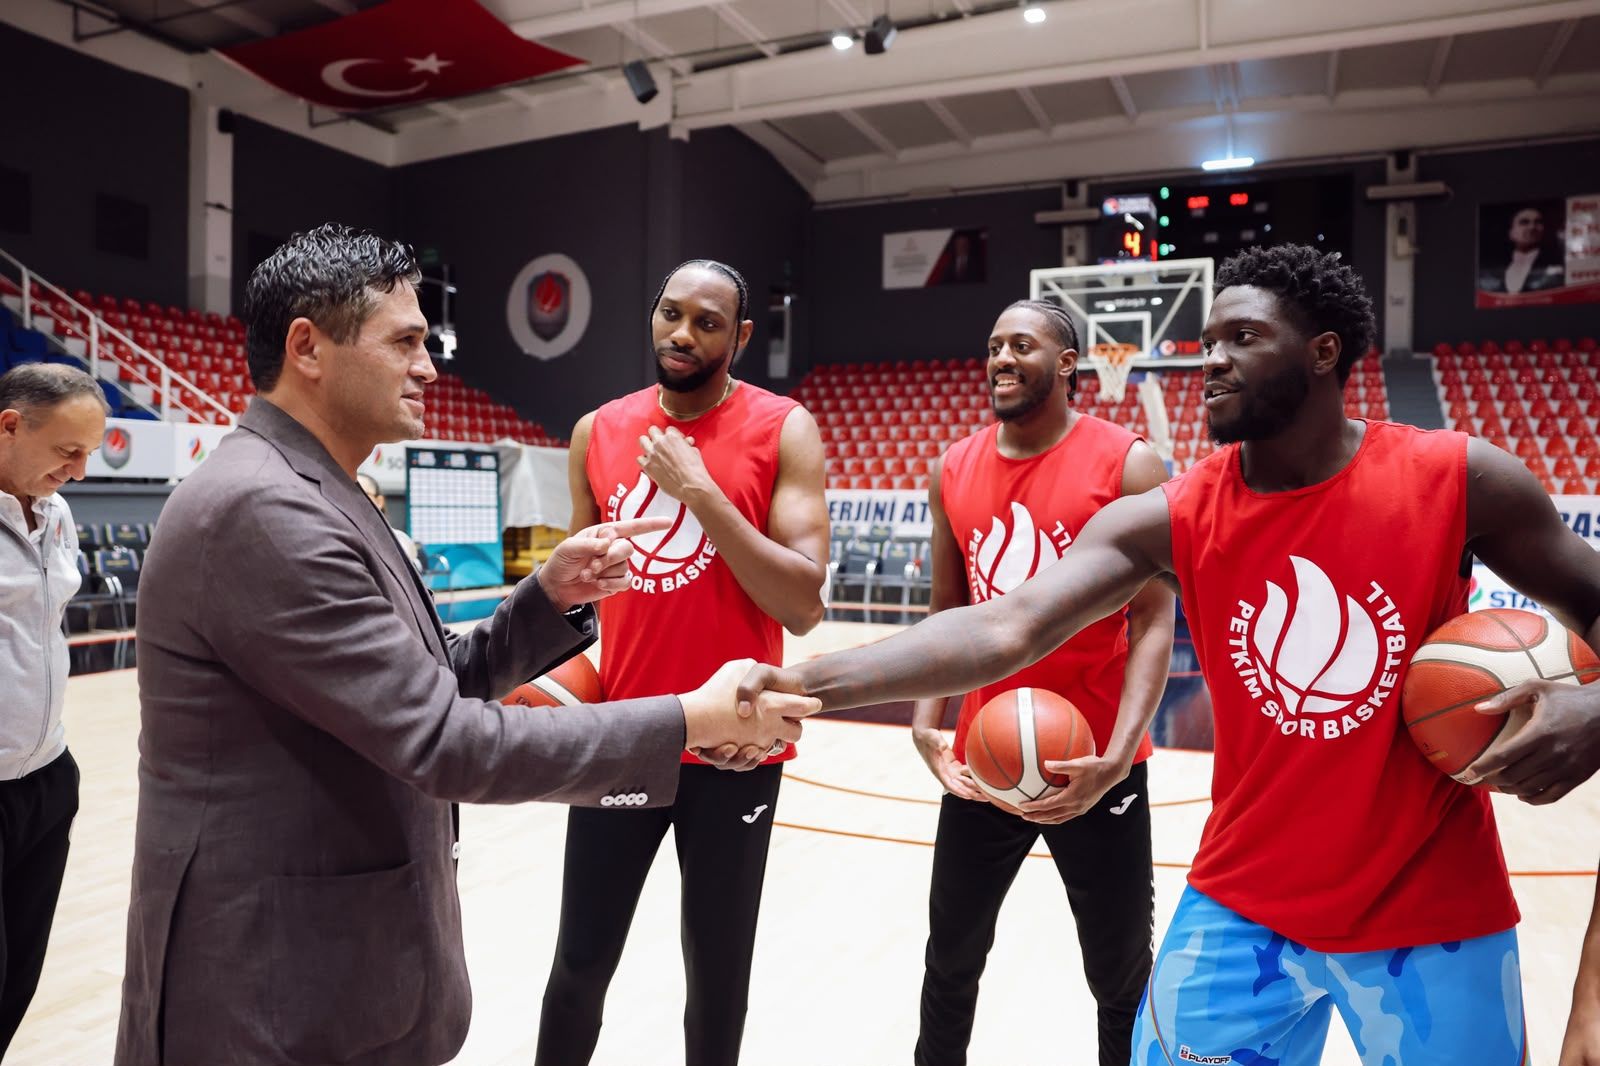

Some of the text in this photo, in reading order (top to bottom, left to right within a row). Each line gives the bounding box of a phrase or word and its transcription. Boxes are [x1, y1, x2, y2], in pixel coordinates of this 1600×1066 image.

[1124, 231, 1141, 257] 4
[607, 482, 628, 521] PET
[661, 538, 717, 593] BASKE
[1490, 591, 1541, 609] STA
[1228, 599, 1263, 699] PETKİM
[1323, 580, 1406, 740] BASKETBALL
[1188, 1053, 1231, 1064] PLAYOFF
